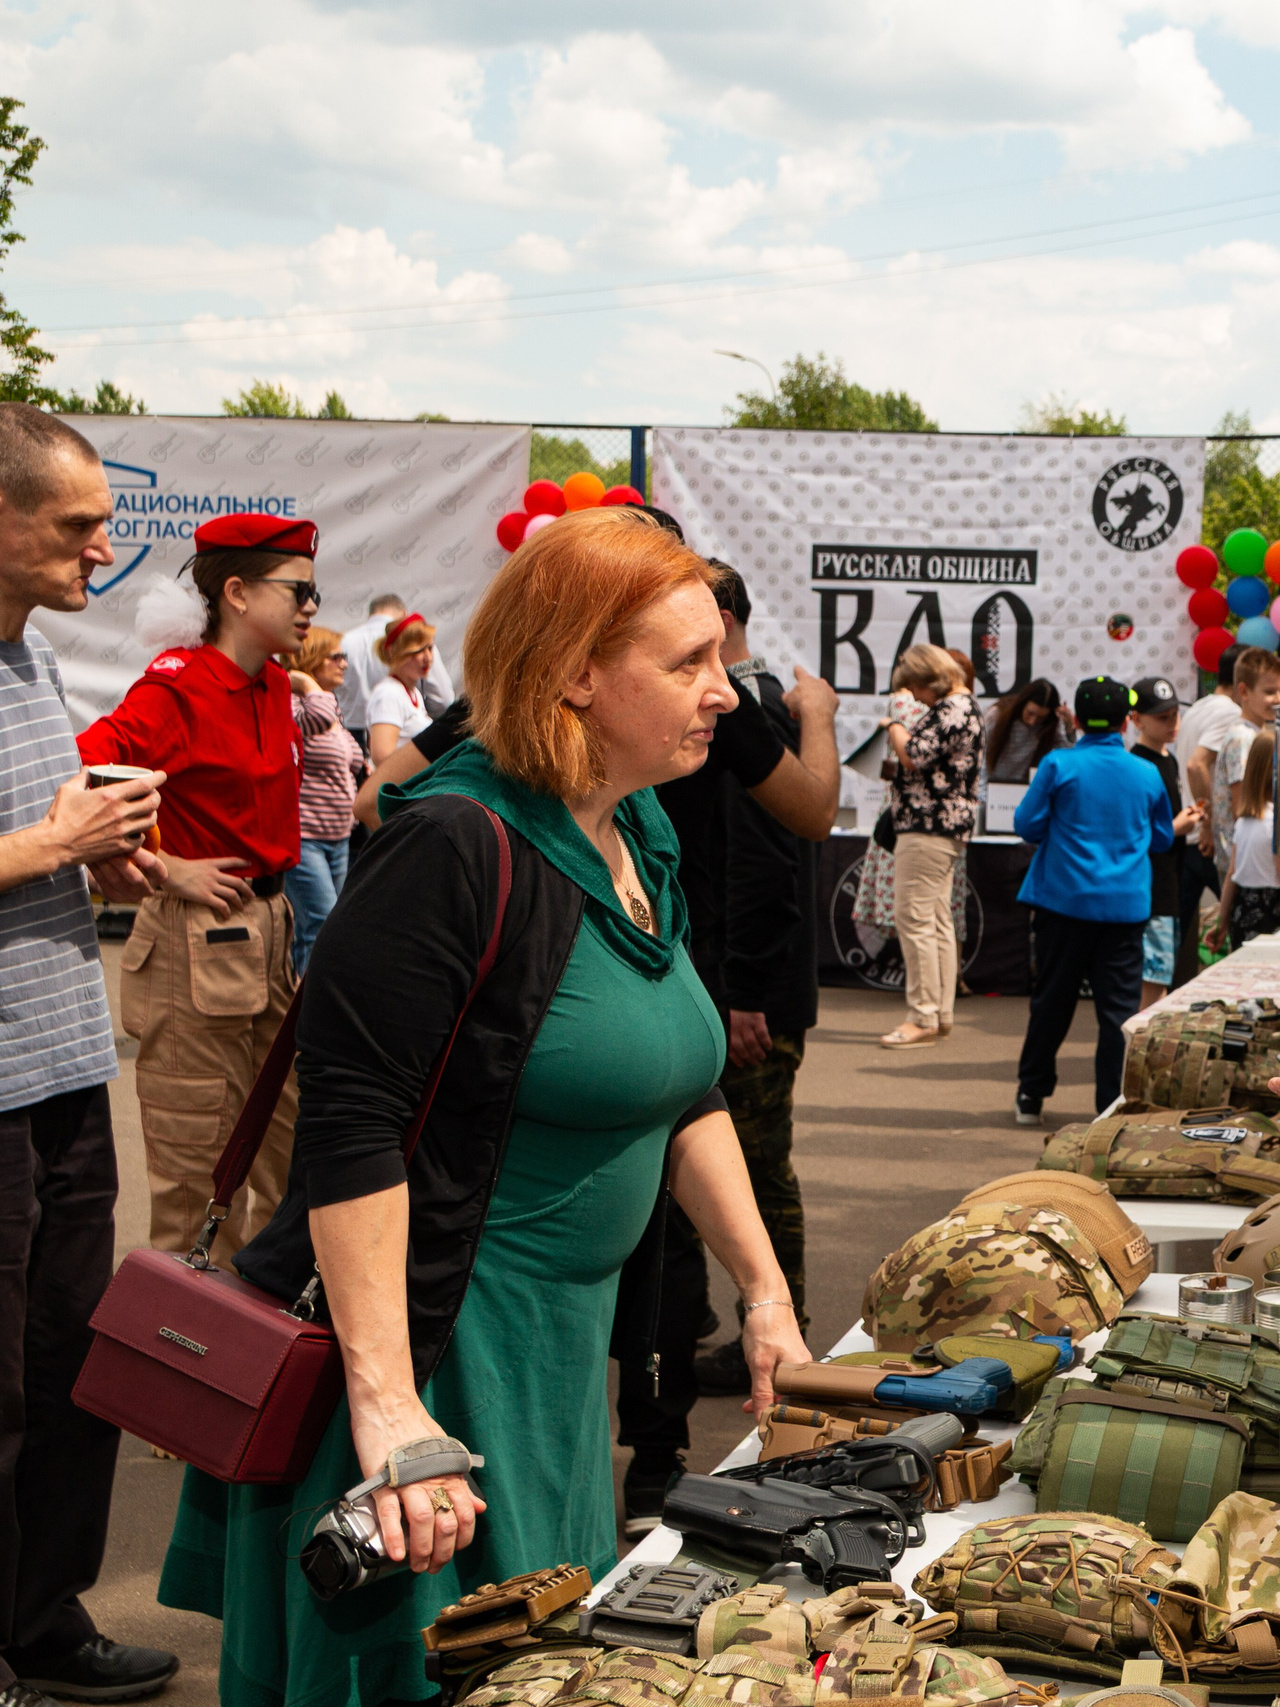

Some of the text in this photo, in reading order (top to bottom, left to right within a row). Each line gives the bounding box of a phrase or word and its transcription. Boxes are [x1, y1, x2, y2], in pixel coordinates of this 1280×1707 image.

[1098, 457, 1180, 493] РУССКАЯ
[112, 494, 297, 518] АЦИОНАЛЬНОЕ
[104, 519, 201, 541] СОГЛАС
[1098, 521, 1174, 553] ОБЩИНА
[816, 552, 1032, 585] РУССКАЯ ОБЩИНА
